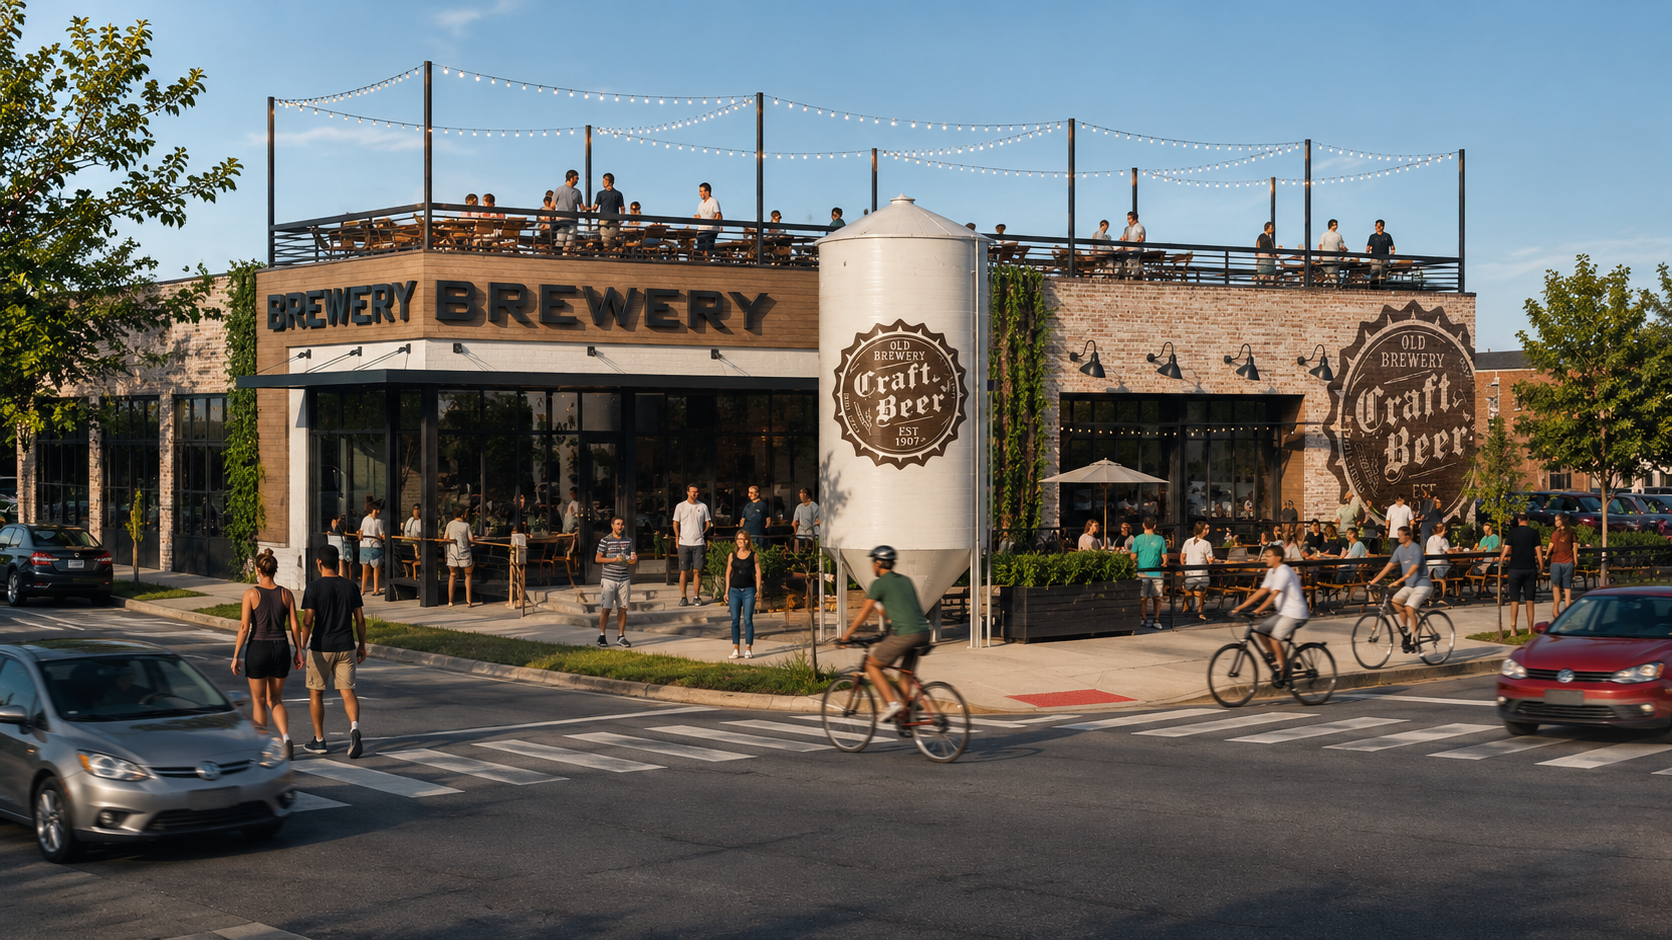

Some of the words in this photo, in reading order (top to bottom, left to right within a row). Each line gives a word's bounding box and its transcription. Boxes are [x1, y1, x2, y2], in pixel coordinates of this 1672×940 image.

[267, 280, 418, 332] BREWERY
[436, 279, 770, 330] BREWERY
[890, 340, 910, 350] OLD
[1401, 334, 1426, 349] OLD
[874, 351, 926, 361] BREWERY
[1380, 352, 1445, 368] BREWERY
[854, 362, 931, 397] Craft
[876, 394, 945, 427] Beer
[1355, 372, 1450, 433] Craft
[895, 437, 920, 446] 1907
[899, 427, 919, 436] EST
[1383, 426, 1468, 484] Beer
